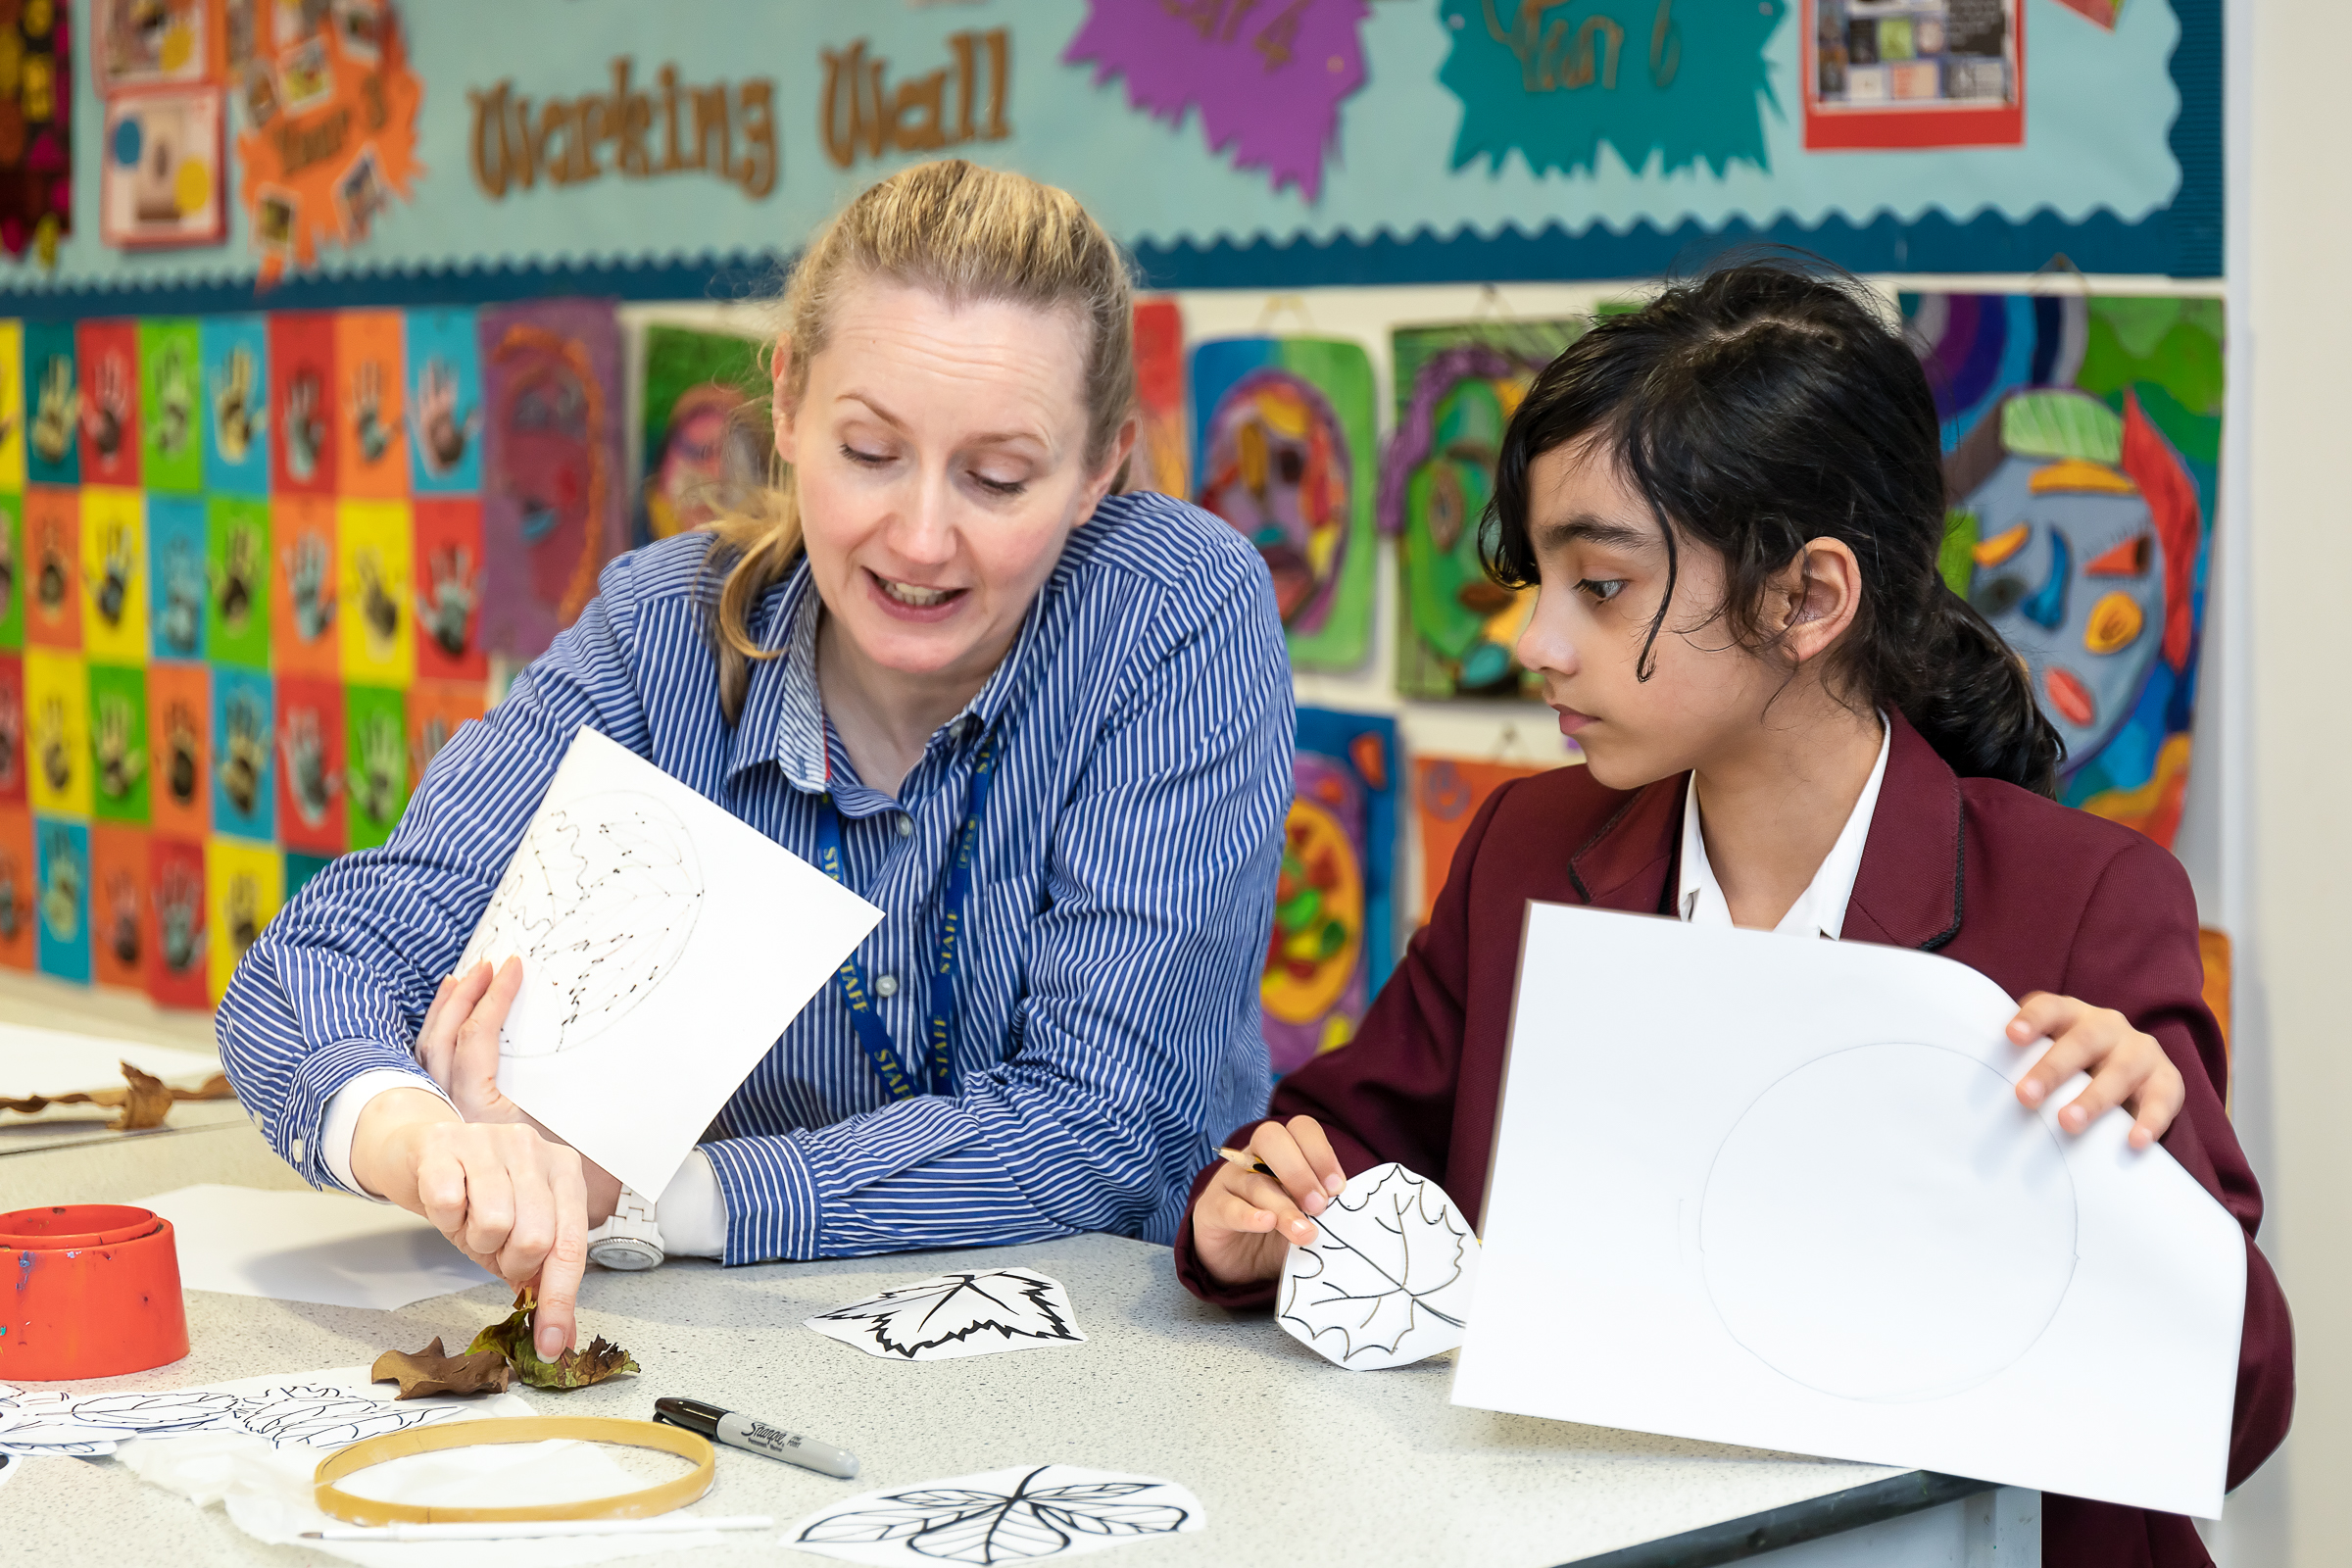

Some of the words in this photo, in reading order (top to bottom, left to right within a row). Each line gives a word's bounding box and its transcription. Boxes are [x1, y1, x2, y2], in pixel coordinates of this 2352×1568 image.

[468, 56, 779, 199] Working
[821, 29, 1010, 168] Wall
[839, 956, 870, 1013] TAFF
